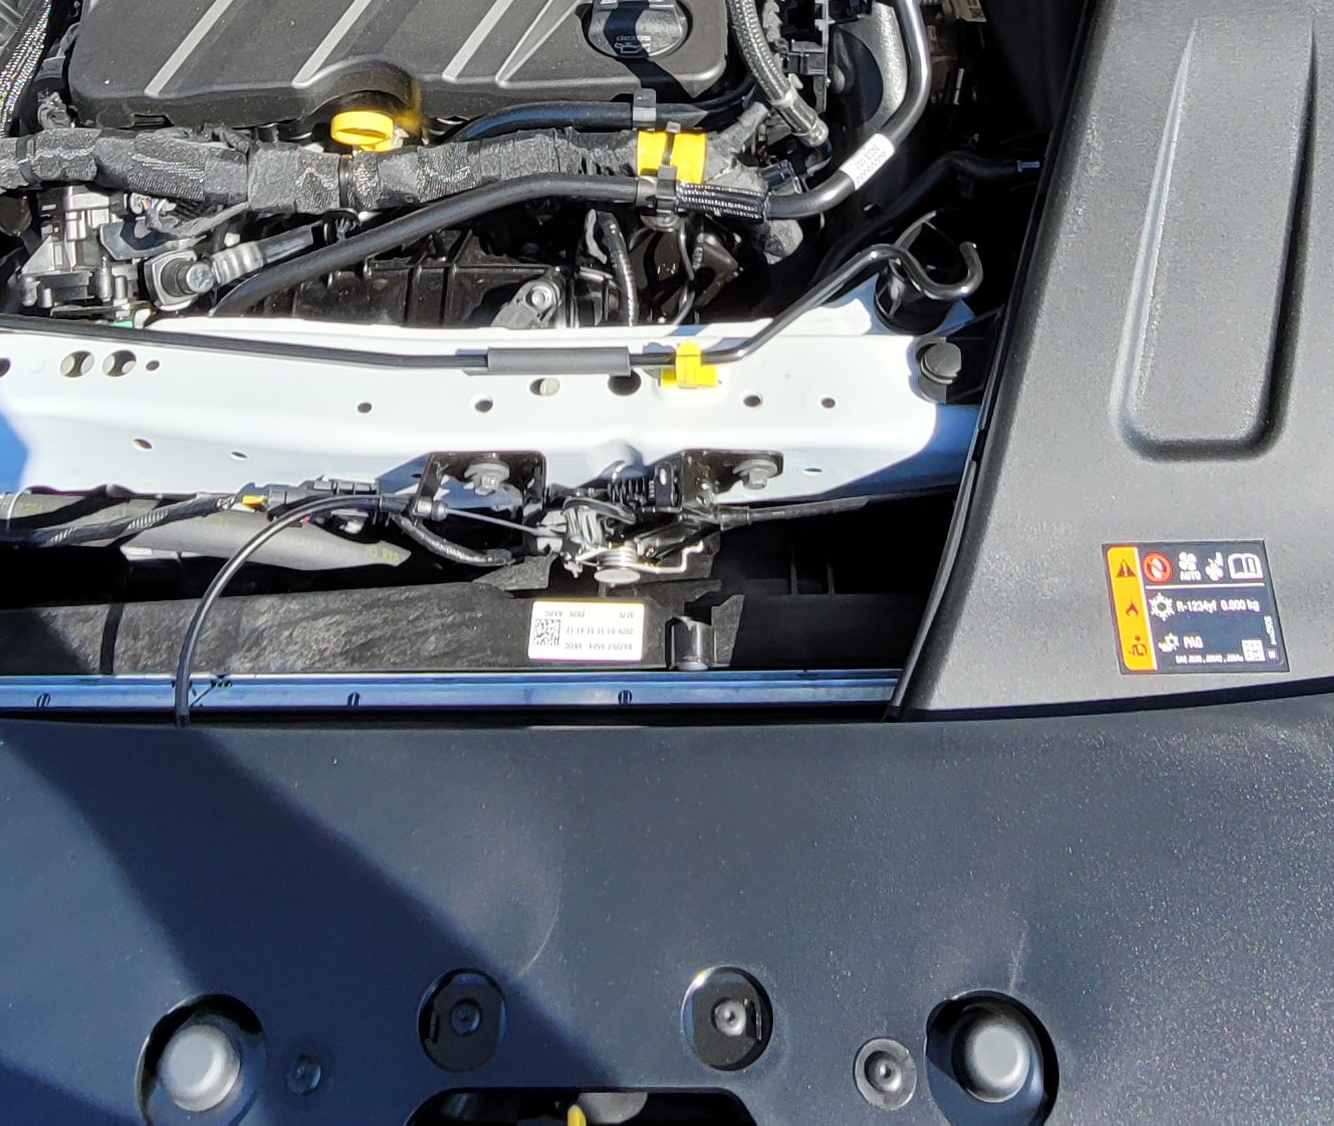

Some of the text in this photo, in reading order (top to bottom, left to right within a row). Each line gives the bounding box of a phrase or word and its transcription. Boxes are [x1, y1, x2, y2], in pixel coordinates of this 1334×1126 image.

[1179, 570, 1202, 581] AUTO
[1246, 598, 1260, 613] kg
[1183, 635, 1204, 649] PAG
